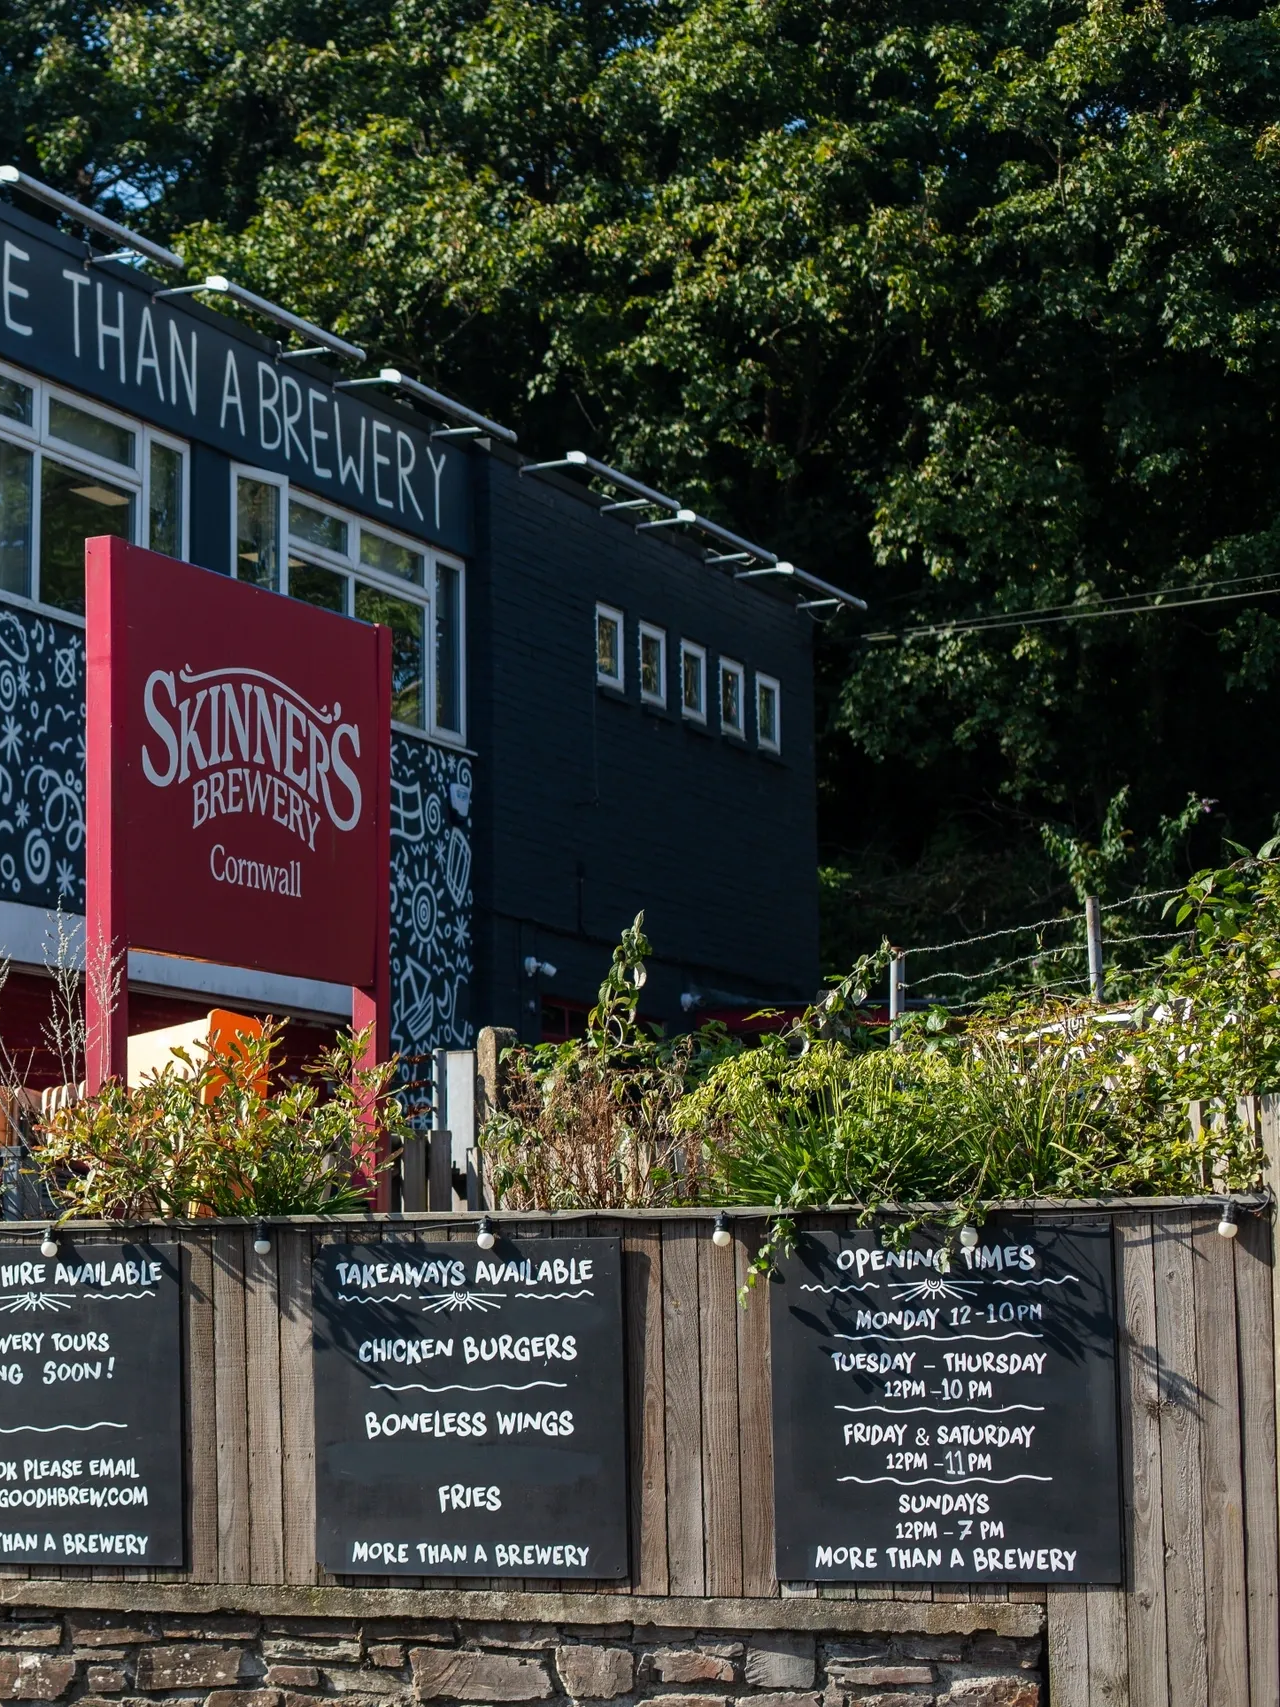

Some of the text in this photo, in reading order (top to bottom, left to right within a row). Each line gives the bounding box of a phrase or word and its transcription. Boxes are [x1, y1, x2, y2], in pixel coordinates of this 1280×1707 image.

[62, 269, 198, 417] THAN
[220, 348, 246, 437] A
[257, 361, 447, 531] BREWERY
[192, 767, 321, 853] BREWERY
[210, 843, 302, 898] Cornwall
[1, 1261, 46, 1288] HIRE
[53, 1259, 163, 1287] AVAILABLE
[335, 1258, 594, 1289] TAKEAWAYS AVAILABLE
[836, 1244, 1036, 1278] OPENING TIMES
[855, 1307, 941, 1331] MONDAY
[51, 1331, 110, 1352] TOURS
[358, 1333, 578, 1365] CHICKEN BURGERS
[42, 1356, 116, 1385] SOON!
[831, 1352, 917, 1374] TUESDAY
[942, 1352, 1048, 1375] THURSDAY
[884, 1380, 926, 1399] 12PM
[365, 1410, 575, 1440] BONELESS WINGS
[843, 1423, 1036, 1448] FRIDAY & SATURDAY
[23, 1458, 83, 1482] PLEASE
[89, 1457, 140, 1479] EMAIL
[886, 1452, 928, 1471] 12PM
[438, 1483, 502, 1514] FRIES
[898, 1493, 990, 1516] SUNDAYS
[895, 1521, 938, 1540] 12PM
[957, 1519, 973, 1541] 7
[980, 1521, 1005, 1540] PM
[43, 1533, 57, 1551] A
[62, 1533, 149, 1556] BREWERY
[352, 1541, 590, 1568] MORE THAN A BREWERY
[815, 1545, 1077, 1572] MORE THAN A BREWERY
